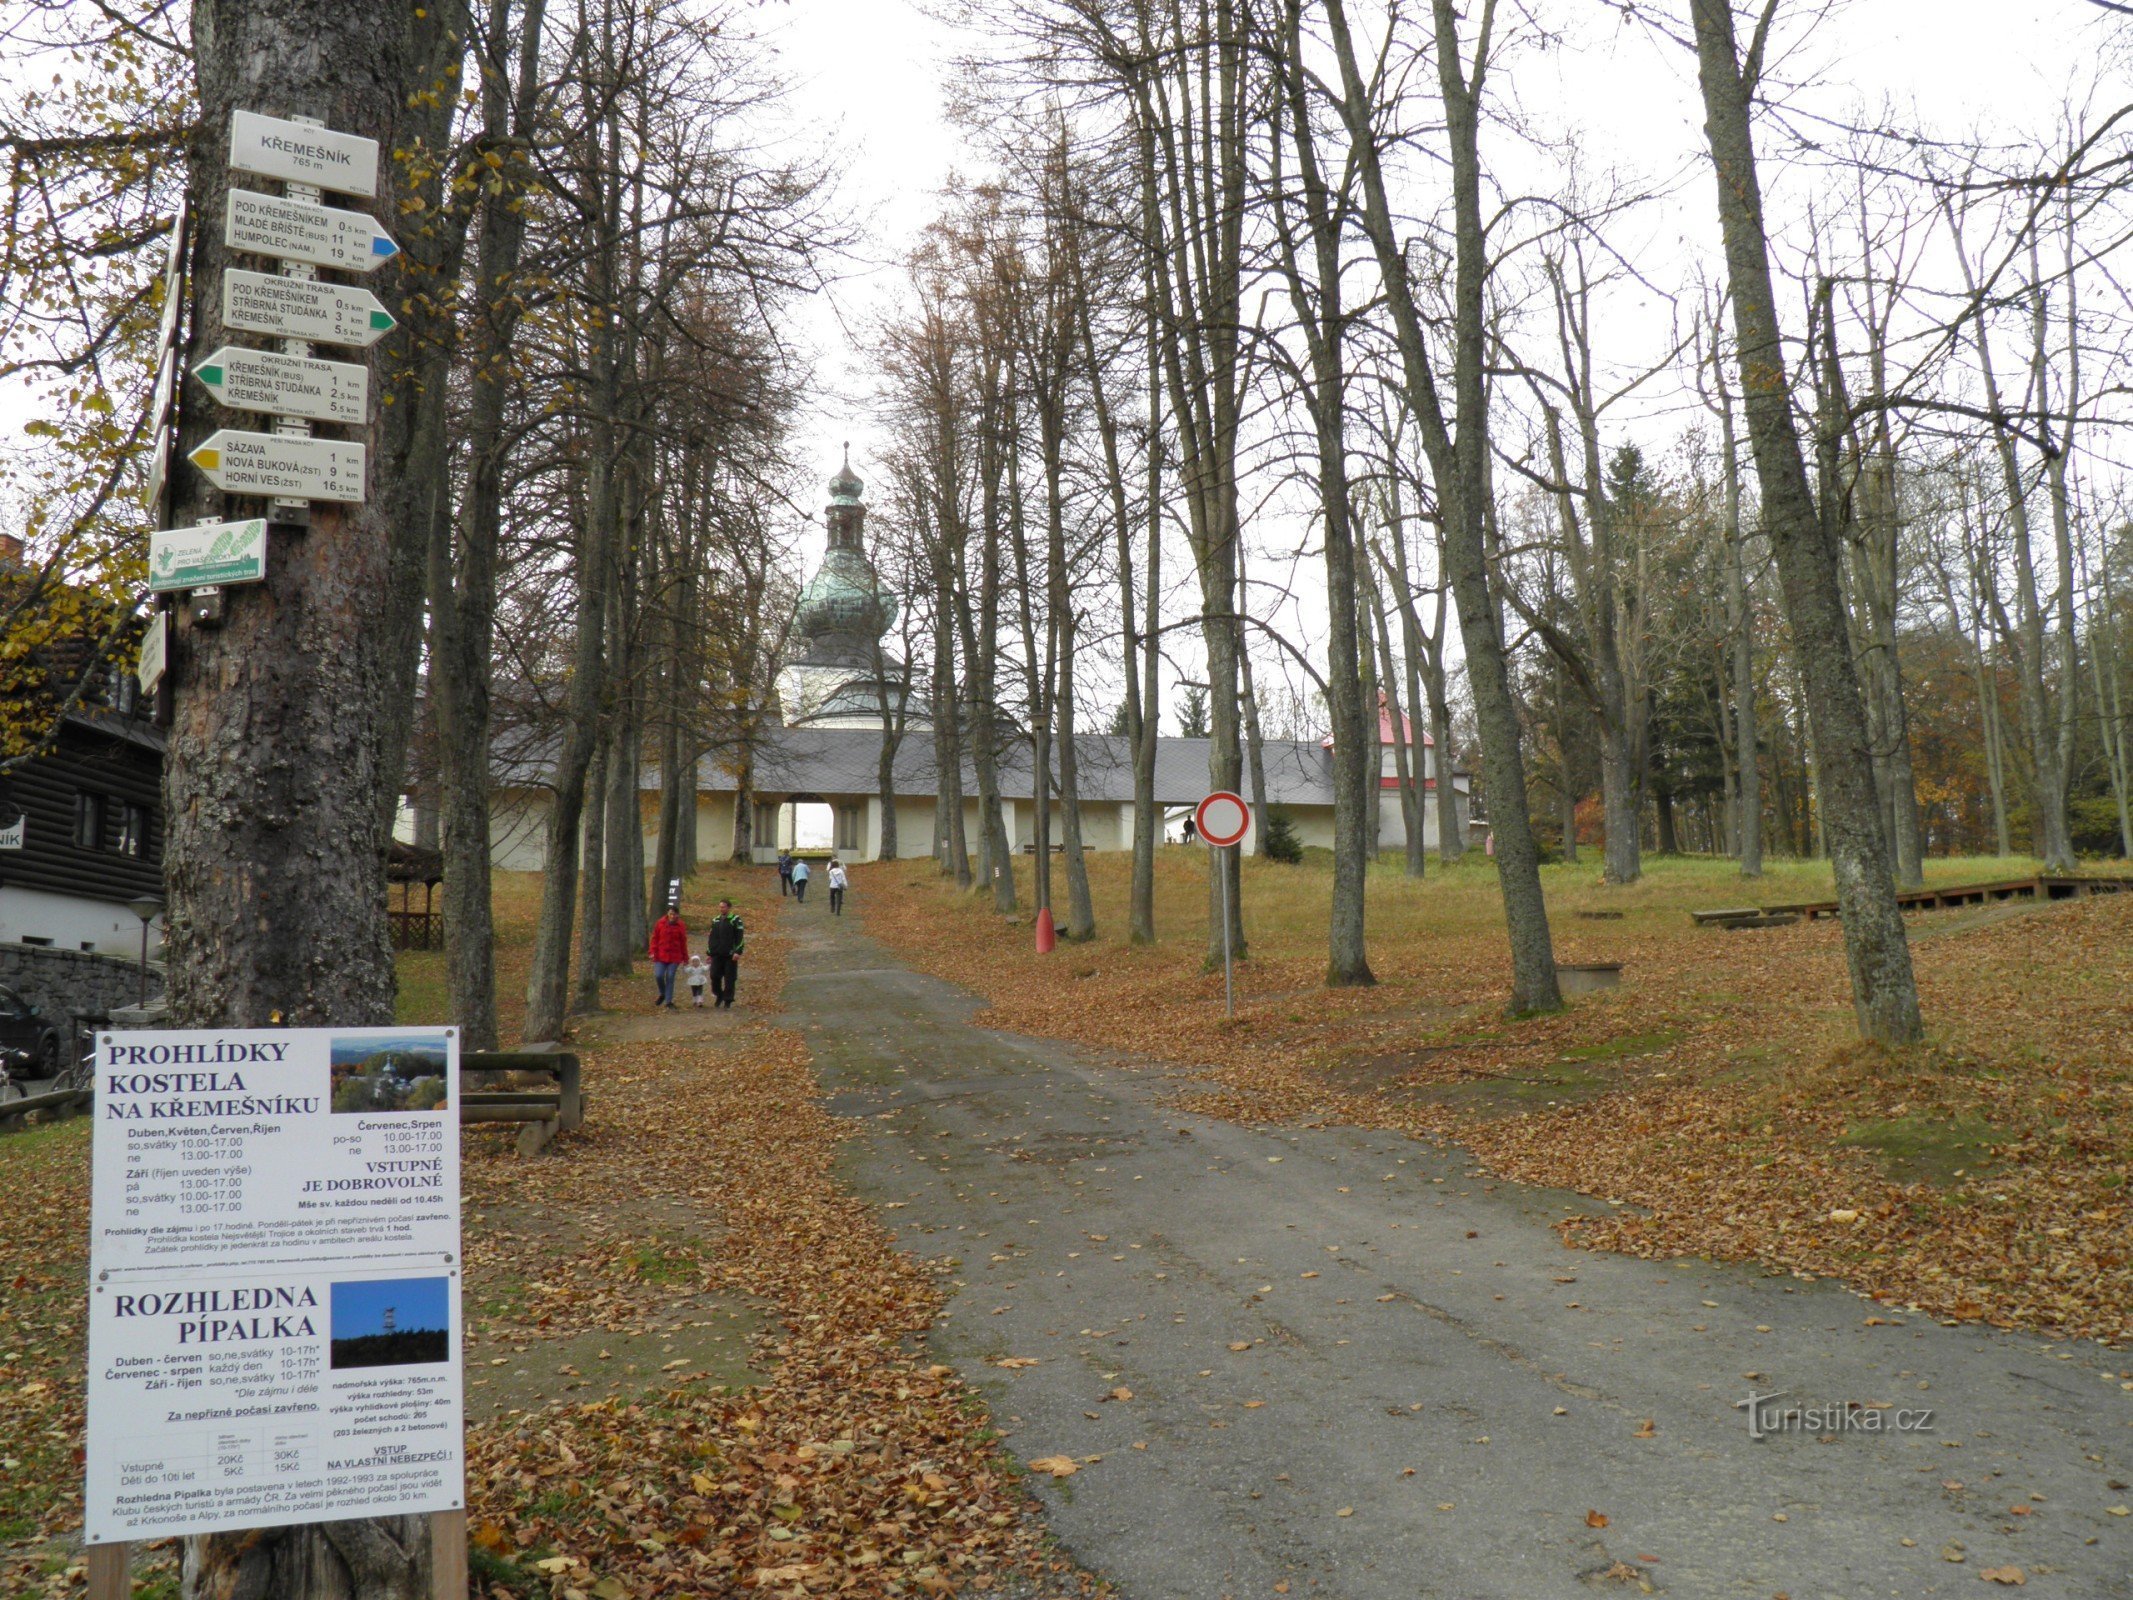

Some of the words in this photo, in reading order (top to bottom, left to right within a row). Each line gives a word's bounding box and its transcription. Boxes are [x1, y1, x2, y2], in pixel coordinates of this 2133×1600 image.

[261, 136, 351, 165] KŘEMEŠNÍK
[293, 156, 311, 167] 765
[314, 162, 323, 170] m
[236, 201, 257, 214] POD
[259, 206, 328, 227] KŘEMEŠNÍKEM
[355, 227, 366, 236] km
[235, 214, 269, 230] MLADÉ
[271, 220, 305, 237] BŘÍŠTĚ
[306, 232, 328, 243] (BUS)
[332, 234, 344, 244] 11
[354, 241, 366, 249] km
[234, 229, 288, 248] HUMPOLEC
[331, 248, 344, 259] 19
[353, 255, 364, 263] km
[264, 277, 304, 290] OKRUŽNÍ
[307, 284, 336, 295] TRASA
[233, 283, 252, 295] POD
[254, 287, 318, 305] KŘEMEŠNÍKEM
[352, 304, 364, 313] km
[233, 296, 277, 312] STŘÍBRNÁ
[280, 303, 328, 320] STUDÁNKA
[336, 311, 342, 321] 3
[351, 317, 363, 325] km
[232, 310, 284, 326] KŘEMEŠNÍK
[350, 329, 363, 337] km
[261, 355, 301, 367] OKRUŽNÍ
[304, 362, 332, 372] TRASA
[230, 361, 280, 378] KŘEMEŠNÍK
[281, 371, 304, 382] (BUS)
[332, 376, 337, 386] 1
[348, 381, 360, 389] km
[229, 375, 273, 390] STŘÍBRNÁ
[275, 380, 321, 396] STUDÁNKA
[347, 394, 360, 402] km
[228, 387, 279, 403] KŘEMEŠNÍK
[347, 406, 359, 415] km
[227, 442, 266, 456] SÁZAVA
[330, 453, 336, 462] 1
[346, 457, 359, 465] km
[226, 456, 255, 469] NOVÁ
[258, 459, 299, 472] BUKOVÁ
[300, 465, 321, 476] (ŽST)
[330, 467, 337, 477] 9
[346, 471, 359, 479] km
[226, 471, 258, 483] HORNÍ
[261, 474, 280, 486] VES
[281, 478, 302, 489] (ŽST)
[346, 485, 358, 493] km
[178, 558, 191, 566] PRO
[108, 1039, 289, 1065] PROHLÍDKY
[108, 1072, 247, 1094] KOSTELA
[107, 1103, 144, 1119] NA
[151, 1095, 320, 1118] KŘEMEŠNÍKU
[128, 1123, 281, 1138] Duben,Květen,Červen,Říjen
[358, 1120, 442, 1131] Červenec,Srpen
[128, 1140, 177, 1150] so,svátky
[182, 1138, 243, 1148] 10.00-17.00
[334, 1135, 362, 1145] po-so
[384, 1131, 442, 1142] 10.00-17.00
[128, 1154, 141, 1162] ne
[181, 1150, 243, 1161] 13.00-17.00
[384, 1143, 442, 1153] 13.00-17.00
[126, 1169, 149, 1179] Září
[152, 1167, 179, 1180] (říjen
[182, 1167, 220, 1176] uveden
[224, 1166, 252, 1176] výše)
[366, 1157, 442, 1173] VSTUPNÉ
[126, 1183, 140, 1193] pá
[180, 1178, 242, 1189] 13.00-17.00
[302, 1181, 323, 1192] JE
[327, 1172, 443, 1191] DOBROVOLNÉ
[126, 1193, 176, 1204] so,svátky
[180, 1190, 242, 1201] 10.00-17.00
[298, 1200, 317, 1209] Mše
[320, 1200, 333, 1208] sv.
[335, 1198, 368, 1207] každou
[371, 1196, 398, 1205] neděli
[401, 1196, 412, 1204] od
[415, 1195, 443, 1203] 10.45h
[126, 1208, 139, 1216] ne
[180, 1202, 242, 1214] 13.00-17.00
[114, 1286, 318, 1318] ROZHLEDNA
[179, 1315, 316, 1344] PÍPALKA
[116, 1357, 153, 1367] Duben
[164, 1354, 202, 1364] červen
[209, 1347, 274, 1362] so,ne,svátky
[105, 1369, 160, 1380] Červenec
[171, 1366, 203, 1377] srpen
[209, 1362, 240, 1374] každý
[243, 1362, 263, 1371] den
[145, 1380, 168, 1390] Září
[177, 1378, 202, 1390] říjen
[210, 1373, 275, 1387] so,ne,svátky
[258, 1386, 289, 1397] zájmu
[298, 1384, 319, 1394] déle
[333, 1380, 377, 1389] nadmořská
[380, 1379, 405, 1387] výška:
[347, 1393, 371, 1401] výška
[373, 1390, 414, 1399] rozhledny:
[168, 1411, 182, 1421] Za
[185, 1408, 232, 1420] nepřízně
[236, 1405, 271, 1418] počasí
[275, 1402, 320, 1413] zavřeno.
[330, 1406, 353, 1414] výška
[356, 1402, 398, 1412] vyhlídkové
[354, 1415, 377, 1424] počet
[413, 1411, 427, 1419] 205
[334, 1429, 350, 1438] (203
[353, 1426, 392, 1436] železných
[408, 1422, 448, 1432] betonové)
[217, 1454, 244, 1466] 20Kč
[274, 1450, 300, 1461] 30Kč
[374, 1445, 407, 1455] VSTUP
[122, 1462, 164, 1473] Vstupné
[327, 1461, 341, 1469] NA
[345, 1455, 387, 1467] VLASTNÍ
[390, 1450, 447, 1463] NEBEZPEČÍ
[121, 1476, 141, 1486] Děti
[145, 1475, 158, 1484] do
[162, 1473, 180, 1482] 10ti
[183, 1471, 195, 1481] let
[224, 1467, 244, 1476] 5Kč
[275, 1462, 300, 1472] 15Kč
[117, 1493, 171, 1505] Rozhledna
[215, 1487, 234, 1496] byla
[237, 1483, 285, 1494] postavena
